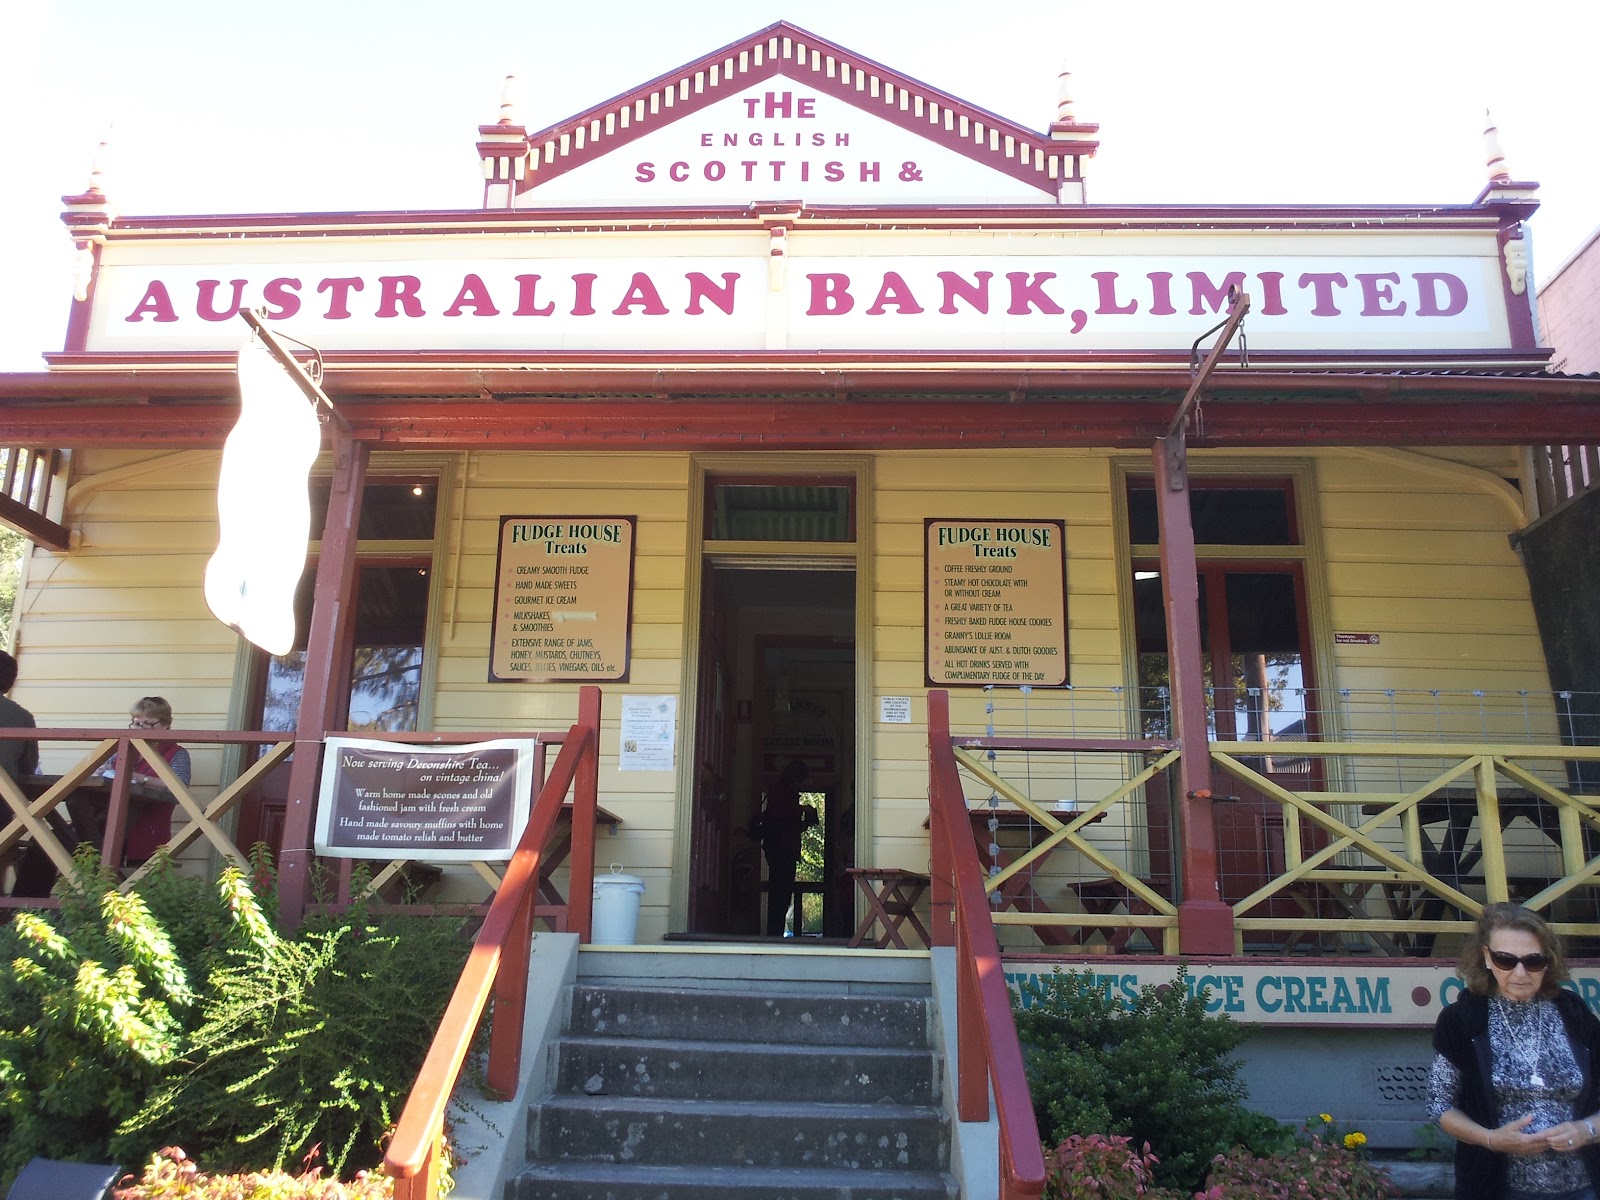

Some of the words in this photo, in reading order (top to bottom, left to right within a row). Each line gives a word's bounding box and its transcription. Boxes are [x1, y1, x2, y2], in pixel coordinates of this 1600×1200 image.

[743, 91, 816, 119] THE
[700, 132, 850, 147] ENGLISH
[634, 160, 881, 183] SCOTTISH
[898, 160, 924, 183] &
[125, 272, 741, 323] AUSTRALIAN
[512, 525, 564, 543] FUDGE
[569, 525, 622, 543] HOUSE
[938, 527, 992, 546] FUDGE
[996, 528, 1052, 547] HOUSE
[545, 541, 587, 554] Treats
[972, 544, 1017, 558] Treats
[516, 566, 541, 575] CREAMY
[542, 566, 568, 575] SMOOTH
[569, 566, 590, 575] FUDGE
[944, 564, 964, 573] COFFEE
[965, 564, 987, 573] FRESHLY
[988, 564, 1013, 573] GROUND
[515, 581, 533, 590] HAND
[534, 581, 553, 590] MADE
[554, 581, 578, 590] SWEETS
[944, 579, 966, 587] STEAMY
[967, 579, 979, 587] HOT
[980, 579, 1012, 587] CHOCOLATE
[1013, 579, 1028, 587] WITH
[944, 589, 953, 598] OR
[955, 589, 980, 598] WITHOUT
[514, 596, 543, 605] GOURMET
[545, 596, 555, 605] ICE
[556, 596, 577, 605] CREAM
[944, 603, 949, 612] A
[950, 603, 967, 612] GREAT
[969, 603, 992, 612] VARIETY
[993, 603, 1001, 612] OF
[513, 611, 551, 621] MILKSHAKES,
[512, 623, 518, 632] &
[519, 623, 554, 632] SMOOTHIES
[944, 617, 967, 626] FRESHLY
[968, 617, 987, 626] BAKED
[988, 617, 1007, 626] FUDGE
[1008, 617, 1027, 626] HOUSE
[1029, 618, 1053, 627] COOKIES
[944, 631, 973, 640] GRANNY'S
[974, 631, 993, 640] LOLLIE
[994, 631, 1012, 640] ROOM
[511, 638, 542, 648] EXTENSIVE
[543, 638, 565, 648] RANGE
[566, 638, 575, 648] OF
[576, 638, 594, 648] JAMS,
[569, 650, 602, 661] CHUTNEYS,
[944, 645, 978, 654] ABUNDANCE
[979, 646, 987, 654] OF
[1005, 646, 1011, 655] &
[1012, 646, 1031, 655] DUTCH
[1032, 647, 1058, 656] GOODIES
[559, 663, 589, 672] VINEGARS,
[591, 663, 605, 672] OILS
[606, 663, 617, 672] etc.
[944, 660, 954, 668] ALL
[956, 660, 968, 668] HOT
[969, 660, 991, 669] DRINKS
[992, 660, 1013, 669] SERVED
[1014, 660, 1030, 669] WITH
[944, 671, 991, 680] COMPLIMENTARY
[992, 671, 1010, 680] FUDGE
[1012, 671, 1020, 680] OF
[1022, 671, 1033, 680] THE
[1034, 671, 1046, 680] DAY
[342, 756, 366, 768] Now
[367, 758, 404, 772] serving
[406, 757, 465, 770] Devonshire
[469, 757, 500, 770] Tea...
[419, 774, 432, 782] on
[435, 773, 471, 785] vintage
[472, 769, 505, 782] china!
[355, 787, 381, 798] Warm
[382, 787, 406, 799] home
[407, 788, 432, 799] made
[461, 788, 478, 799] and
[479, 788, 493, 799] old
[358, 799, 398, 812] fashioned
[400, 803, 416, 814] jam
[418, 801, 436, 812] with
[438, 801, 459, 812] fresh
[339, 816, 365, 827] Hand
[365, 817, 389, 828] made
[390, 821, 422, 831] savoury
[424, 817, 457, 829] muffins
[458, 817, 477, 829] with
[479, 817, 504, 829] home
[357, 829, 380, 841] made
[381, 832, 412, 841] tomato
[414, 830, 437, 841] relish
[438, 830, 455, 841] and
[457, 830, 485, 842] butter
[1183, 974, 1245, 1014] ICE
[1255, 974, 1393, 1014] CREAM
